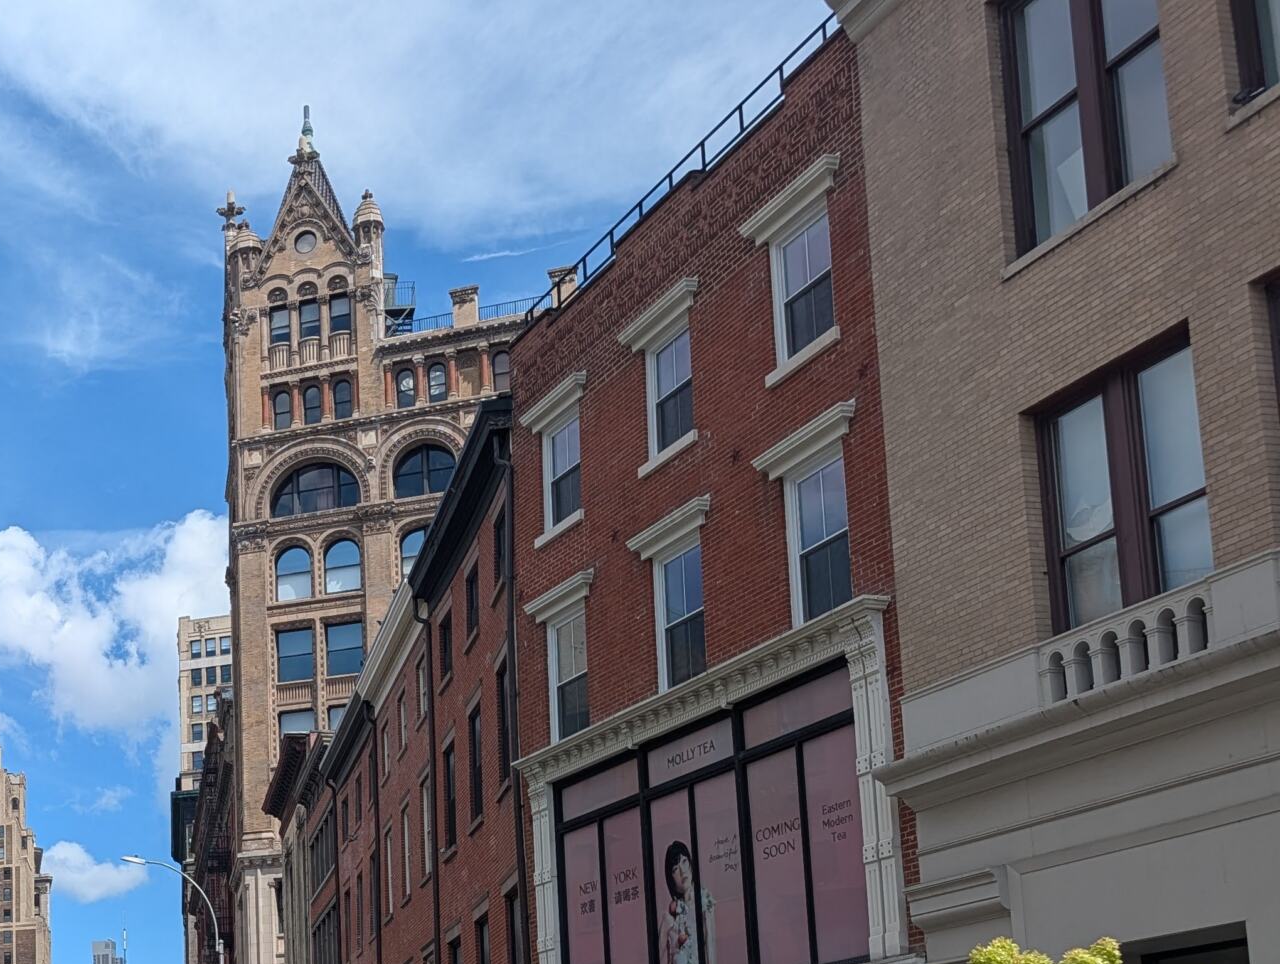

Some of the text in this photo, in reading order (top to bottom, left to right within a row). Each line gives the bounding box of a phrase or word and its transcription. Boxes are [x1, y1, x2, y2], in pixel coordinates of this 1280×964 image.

[666, 739, 716, 769] MOLLY TEA
[821, 800, 852, 816] Eastern
[755, 817, 801, 843] COMING
[822, 813, 854, 829] Modern
[831, 831, 847, 842] Tea
[762, 839, 796, 860] SOON
[579, 867, 638, 896] NEW YORK
